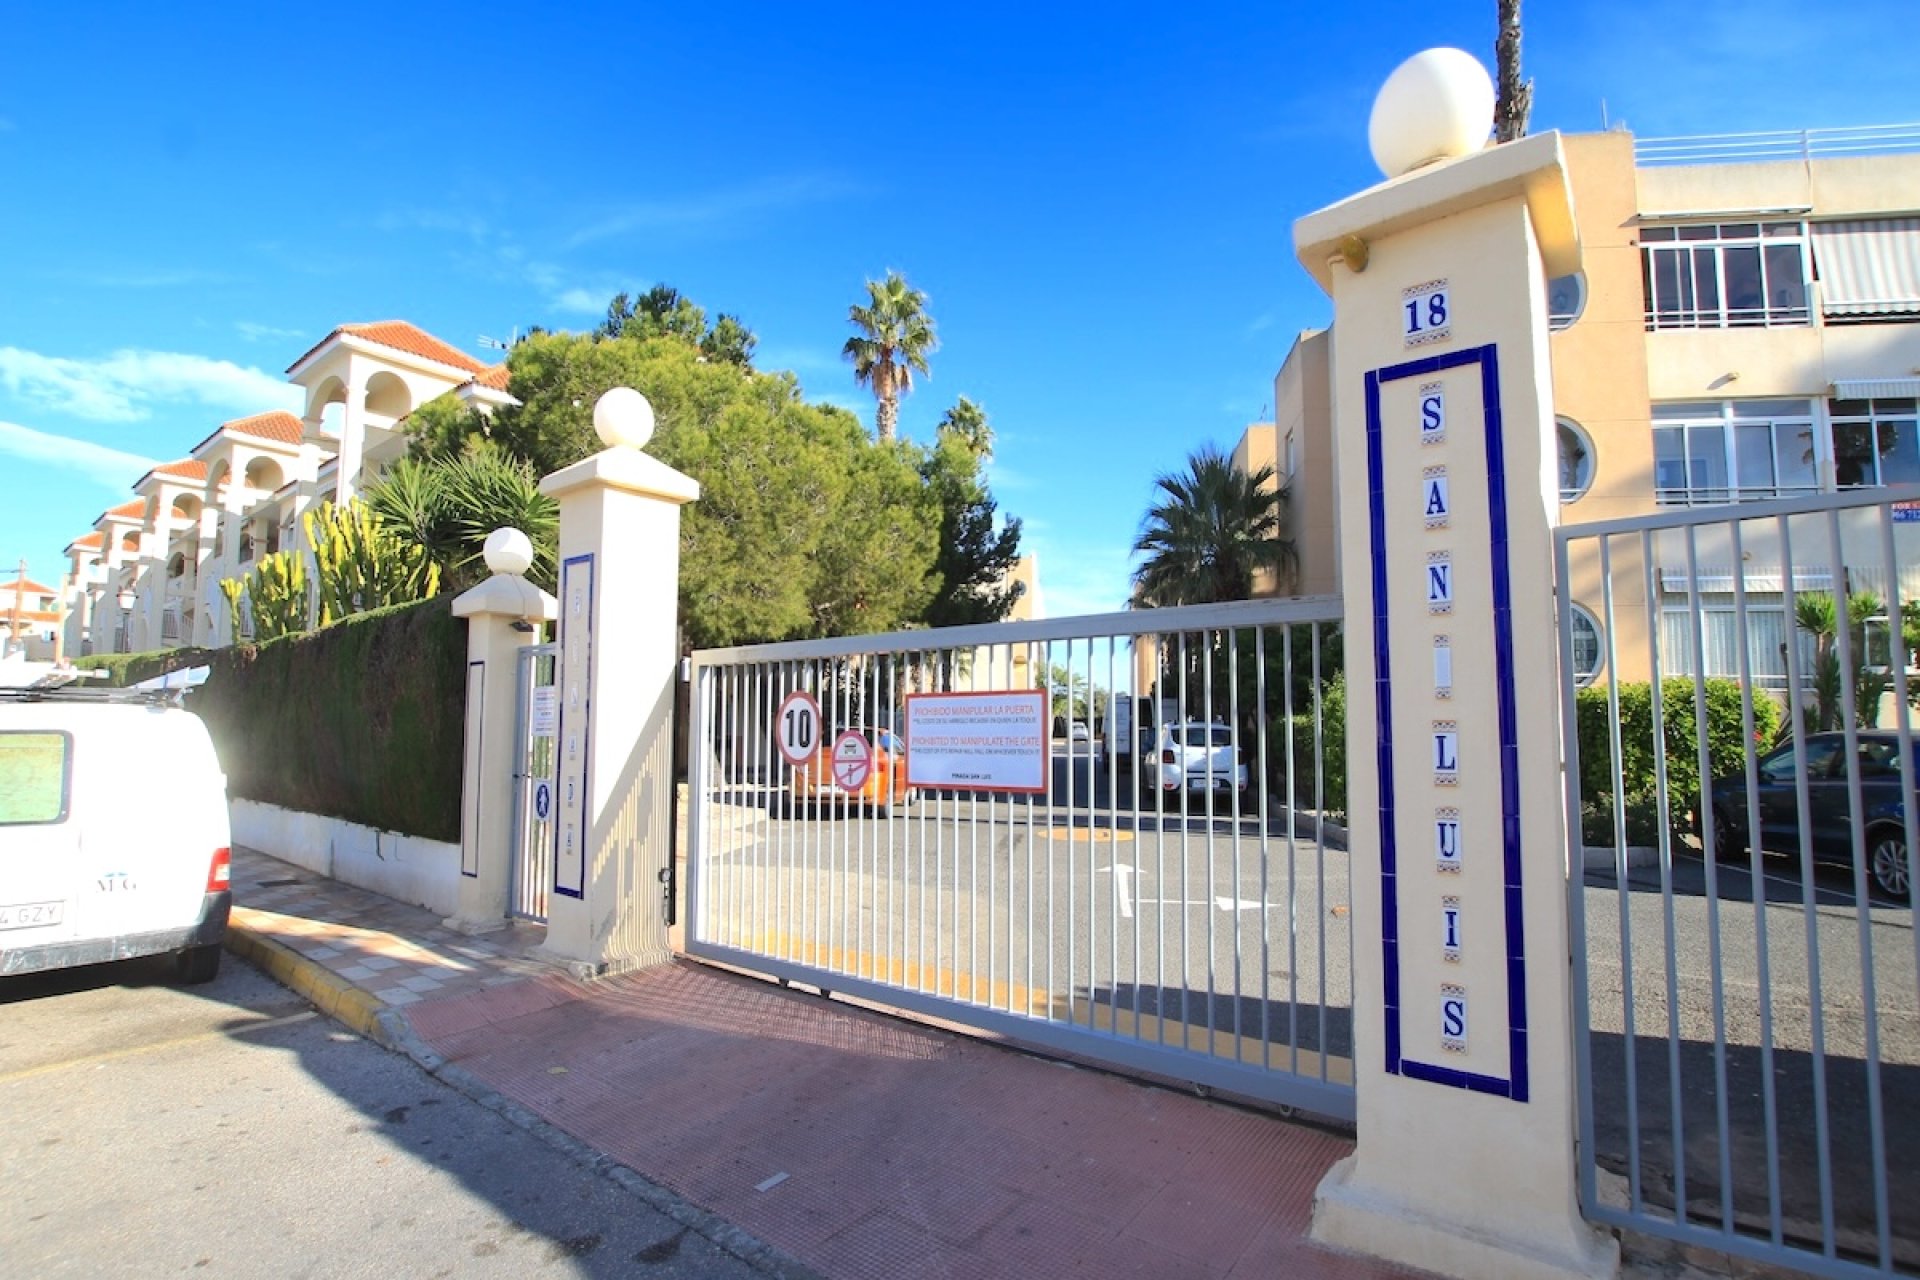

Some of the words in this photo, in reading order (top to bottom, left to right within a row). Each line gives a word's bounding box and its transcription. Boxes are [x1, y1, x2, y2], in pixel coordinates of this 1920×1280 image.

[1405, 293, 1447, 334] 18
[1422, 396, 1448, 600] SAN
[785, 709, 812, 748] 10
[914, 706, 951, 716] PROHIBIDO
[951, 705, 993, 716] MANIPULAR
[994, 705, 1004, 715] LA
[1005, 704, 1034, 714] PUERTA
[911, 736, 949, 745] PROHIBITED
[950, 736, 959, 745] TO
[960, 736, 1004, 746] MANIPULATE
[1005, 736, 1019, 746] THE
[1020, 737, 1040, 746] GATE
[1435, 735, 1464, 1037] LUIS
[18, 904, 57, 924] GZY
